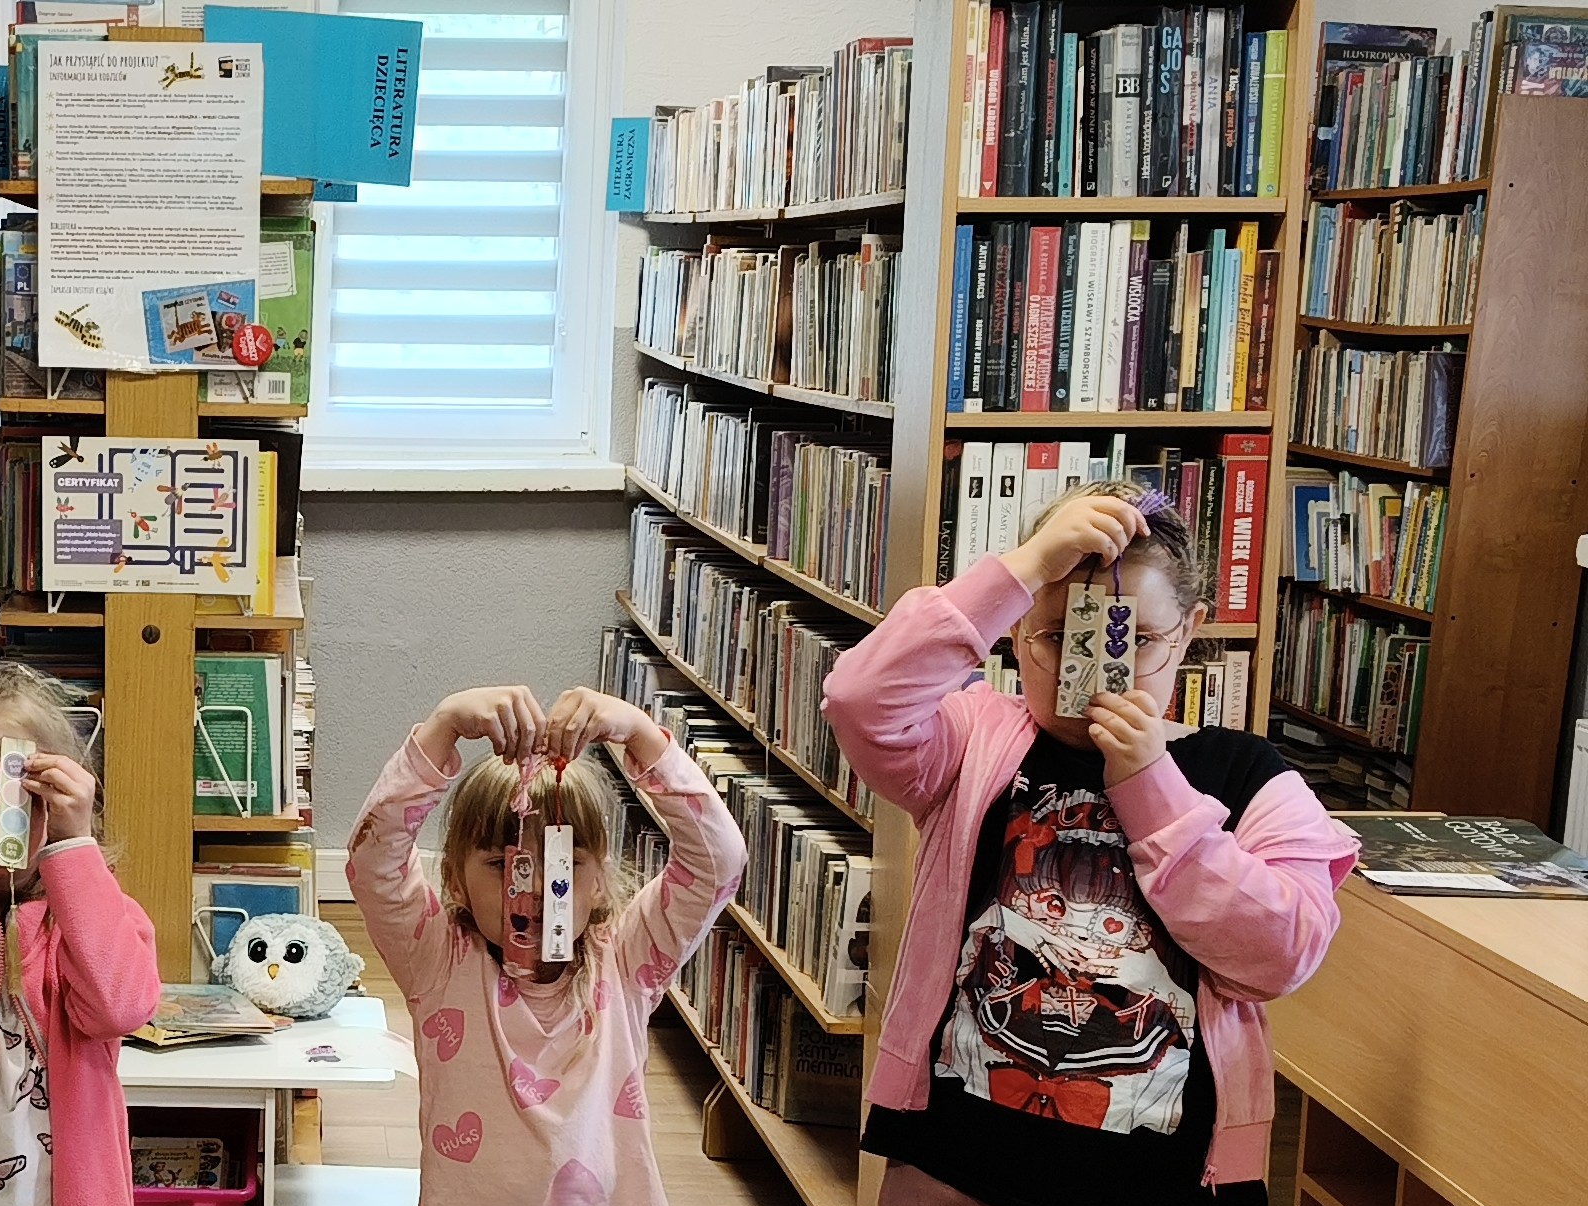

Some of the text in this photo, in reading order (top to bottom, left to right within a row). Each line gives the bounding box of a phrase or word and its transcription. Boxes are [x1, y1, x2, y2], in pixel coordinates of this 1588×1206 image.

[1021, 51, 1029, 66] jest
[1162, 27, 1182, 49] GA
[50, 53, 159, 69] JAK PRZYSTĄPIĆ DO PROJEKTU?
[1019, 68, 1028, 85] Jam
[1161, 50, 1181, 71] JO
[369, 55, 389, 149] DZIECIĘCA
[388, 48, 408, 159] LITERATURA
[1118, 78, 1140, 94] BB
[1160, 72, 1170, 93] S
[1208, 77, 1218, 110] ANIA
[613, 133, 624, 196] LITERATURA
[624, 128, 635, 200] ZAGRANICZNA
[978, 244, 988, 270] ARTUR
[17, 281, 30, 291] PL
[993, 244, 1008, 346] STECZKOWSCY
[1127, 275, 1142, 323] WISŁOCKA
[1026, 303, 1039, 348] AGNIESZCE
[1081, 229, 1098, 393] BIOGRAFIA WISŁAWY SZYMBORSKIEJ
[1237, 274, 1254, 343] Hanka Bielicka
[1036, 295, 1056, 392] POTARGANA W MIŁOŚCI
[1024, 351, 1037, 391] OSIECKIEJ
[57, 477, 120, 488] CERTYFIKAT
[969, 505, 978, 555] NIEPOKORNE
[937, 520, 954, 587] ŁĄCZNICZK
[1228, 517, 1253, 610] WIEK KRWI
[1232, 662, 1242, 709] BARBARA
[795, 1058, 863, 1079] MENTALN
[440, 1128, 480, 1154] HUGS
